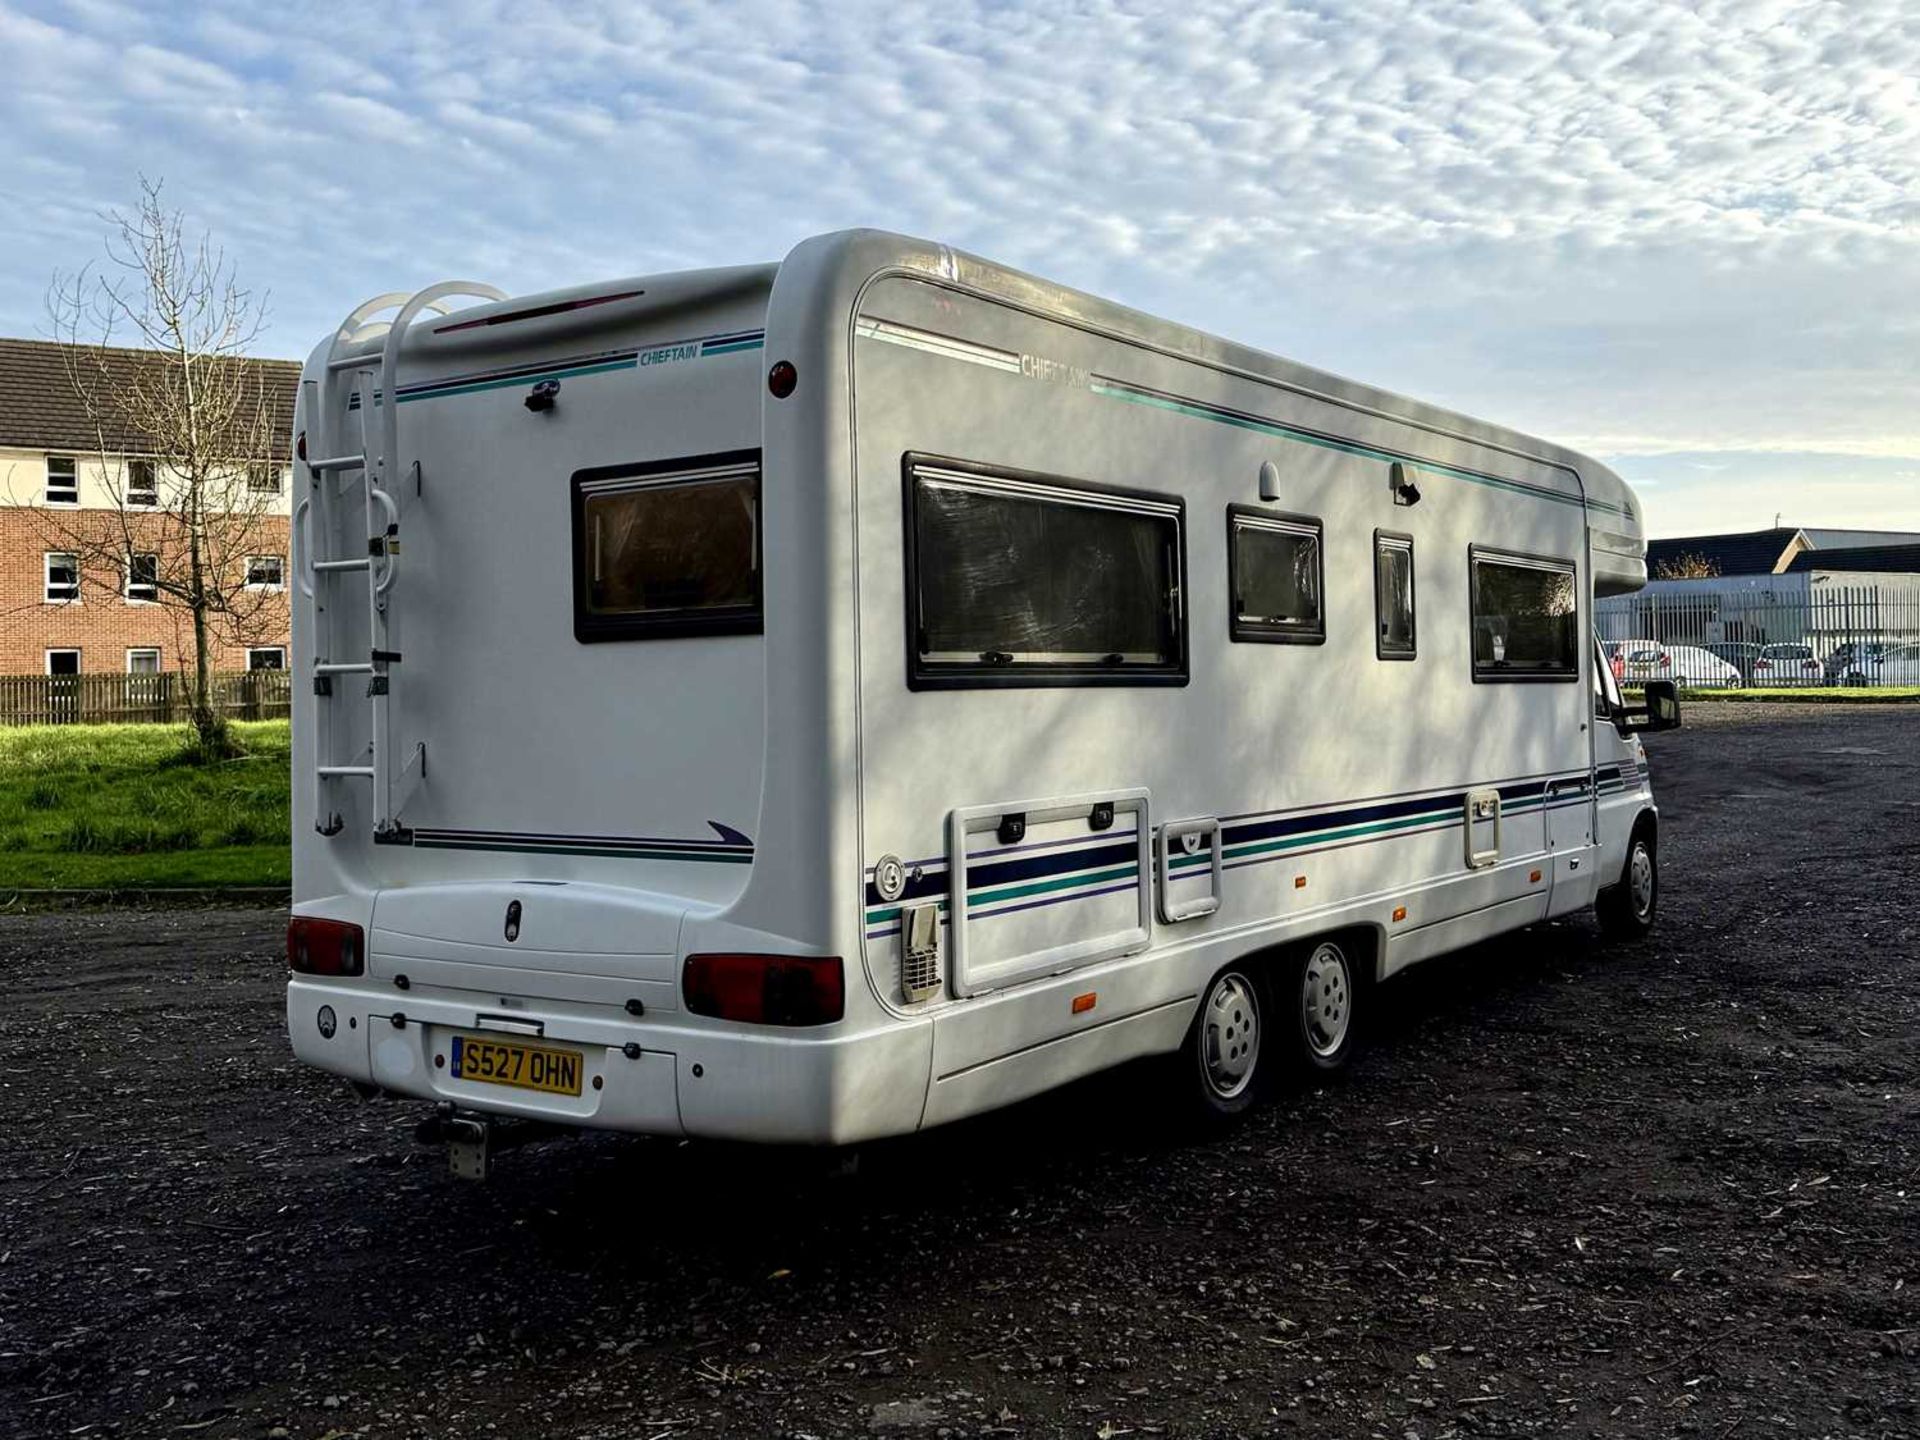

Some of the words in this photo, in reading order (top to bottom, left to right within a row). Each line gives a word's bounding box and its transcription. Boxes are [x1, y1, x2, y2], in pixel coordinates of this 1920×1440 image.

[641, 346, 697, 366] CHIEFTAIN
[466, 1044, 524, 1080] S527
[530, 1053, 576, 1088] OHN
